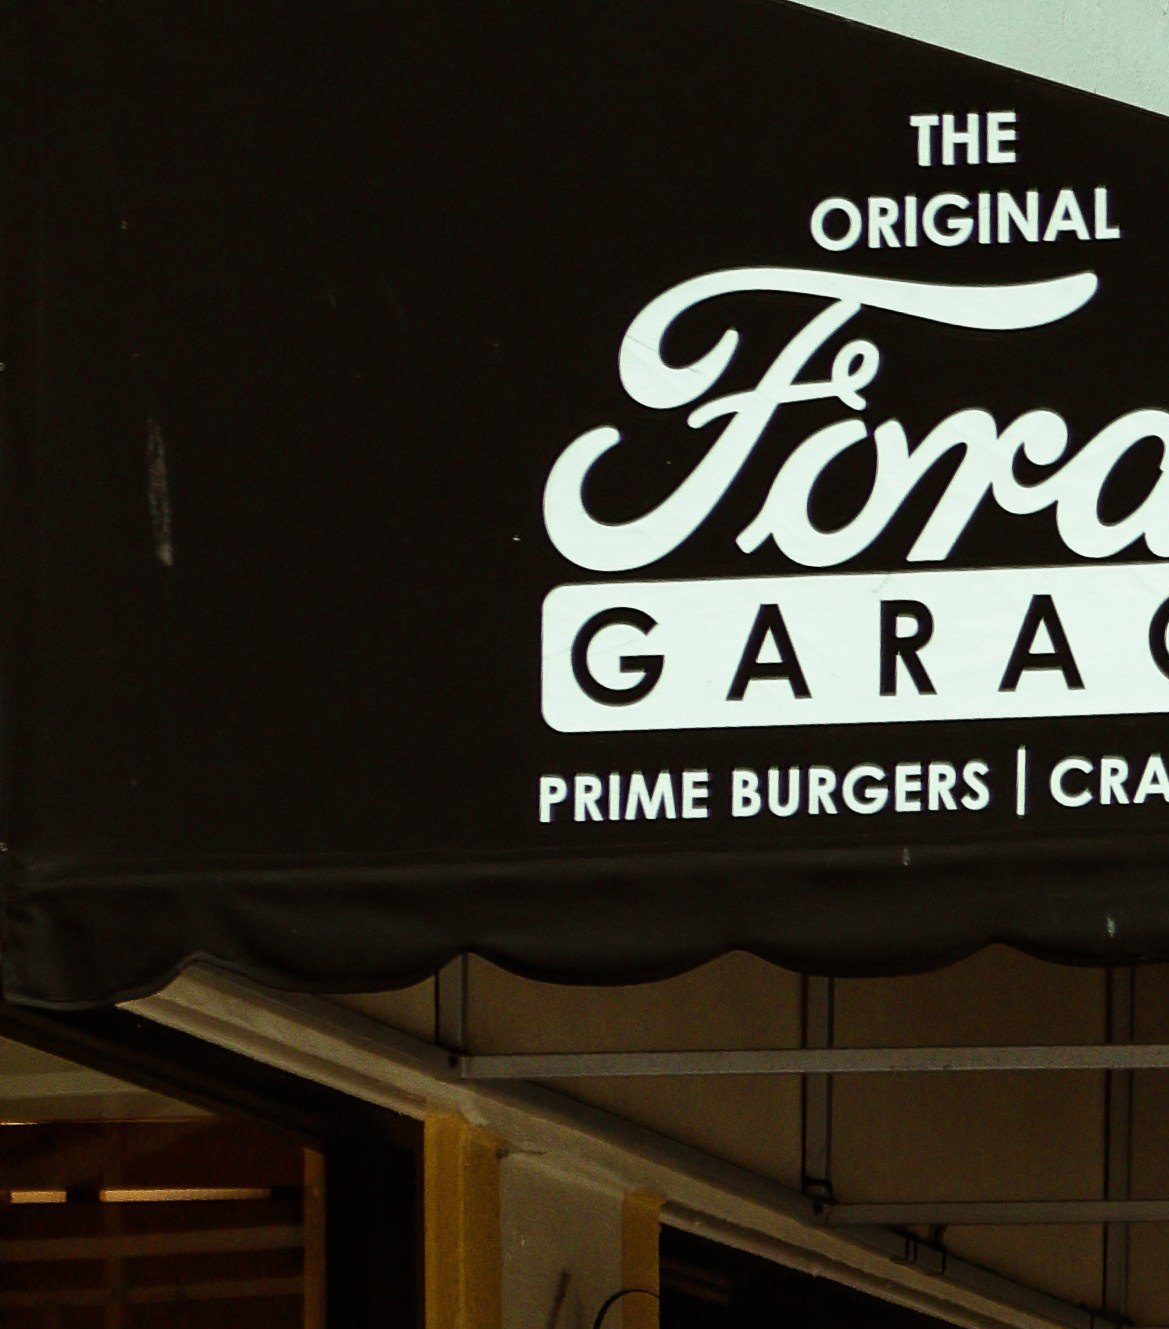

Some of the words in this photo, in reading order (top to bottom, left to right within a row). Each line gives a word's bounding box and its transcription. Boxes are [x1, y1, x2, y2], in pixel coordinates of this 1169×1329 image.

[909, 111, 1017, 167] THE
[810, 186, 1121, 252] ORIGINAL
[539, 766, 709, 823] PRIME
[731, 760, 990, 818] BURGERS
